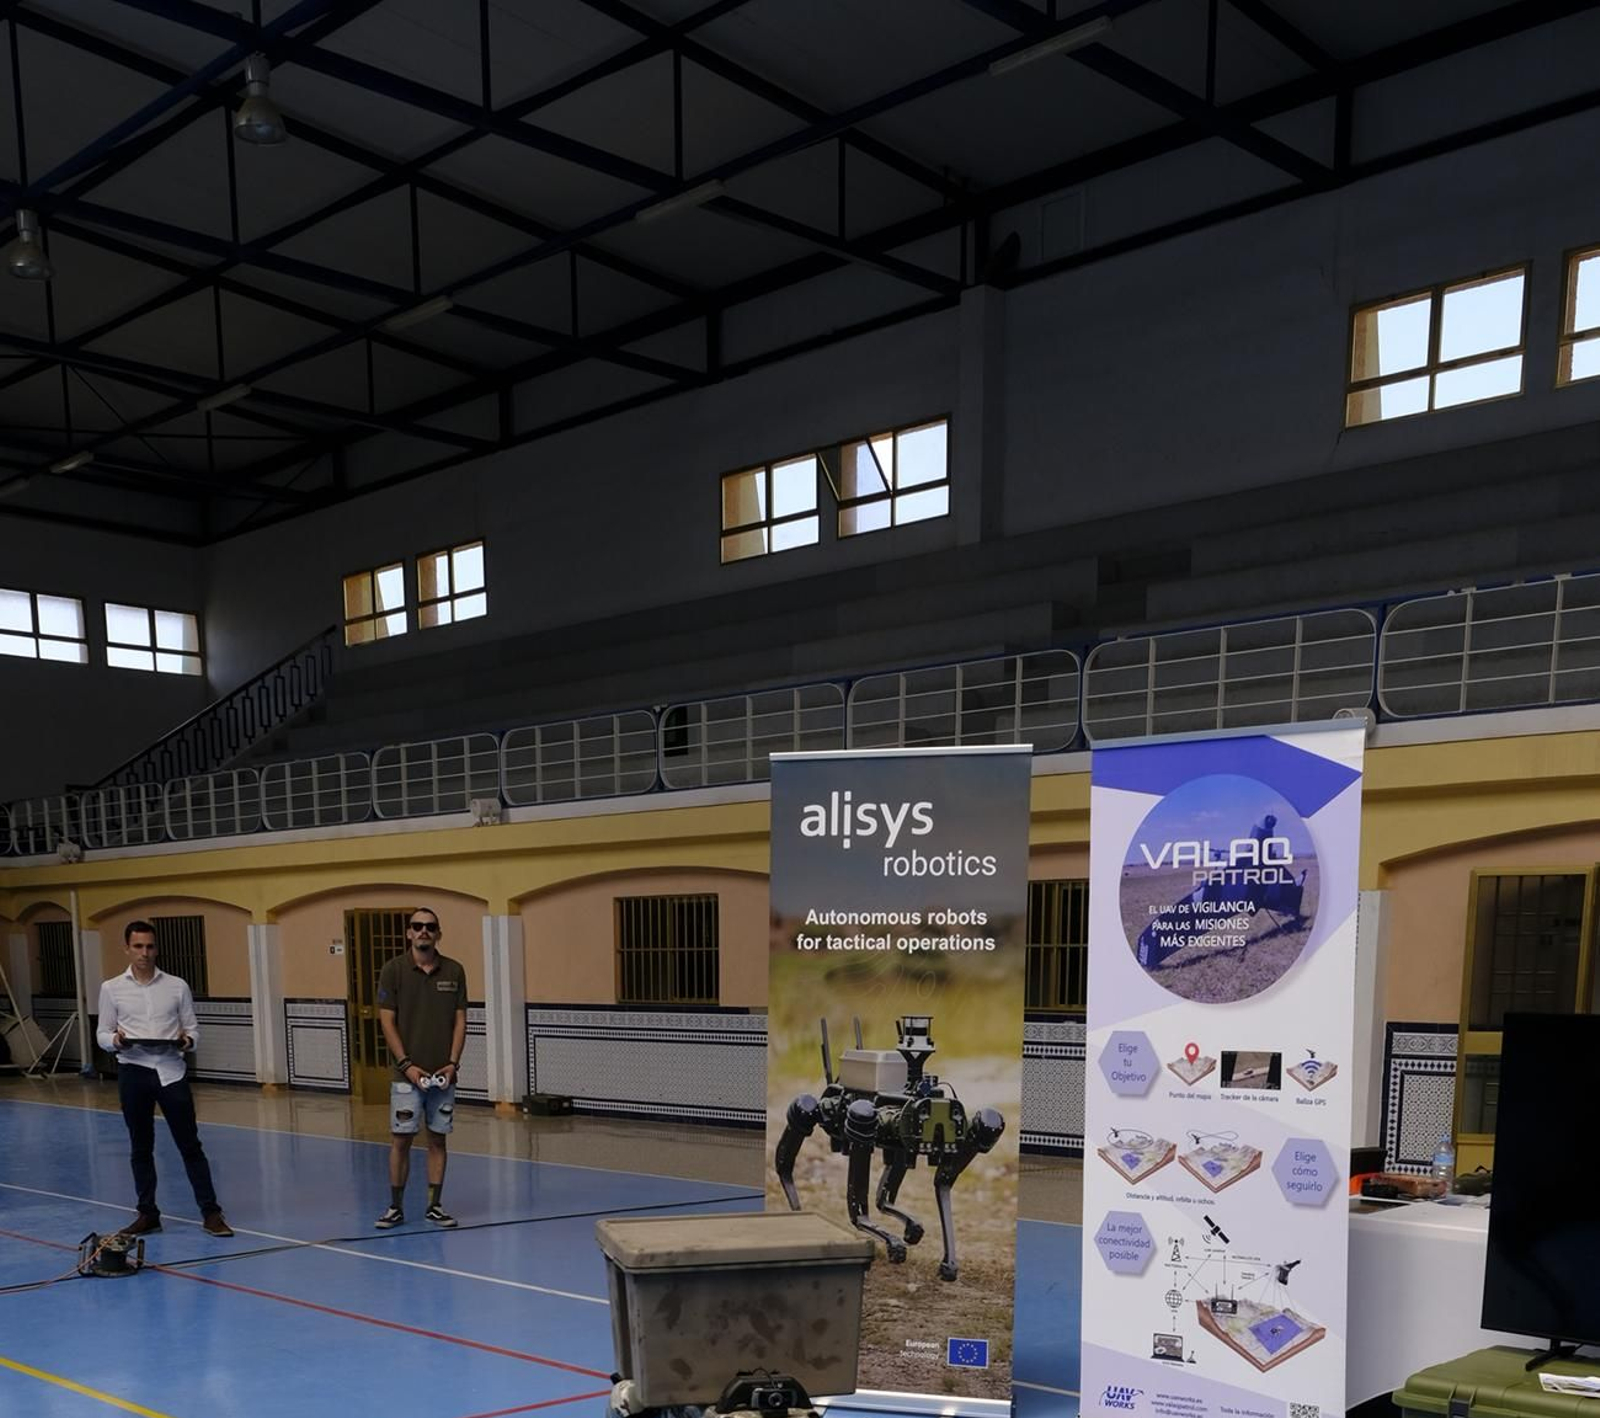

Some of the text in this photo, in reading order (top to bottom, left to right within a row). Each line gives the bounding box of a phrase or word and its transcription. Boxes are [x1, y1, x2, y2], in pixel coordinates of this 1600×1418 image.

[800, 791, 934, 849] alisys
[1140, 837, 1293, 869] VALAQ
[883, 850, 997, 877] robotics
[1192, 868, 1293, 886] PATROL
[1149, 901, 1256, 914] EL UAV DE VIGILANCIA
[805, 909, 988, 925] Autonomous robots
[1152, 918, 1249, 931] PARA LAS MISIONES
[797, 933, 996, 954] for tactical operations
[1160, 933, 1246, 947] MÁS EXIGENTES
[1118, 1043, 1138, 1055] Elige
[1124, 1059, 1132, 1067] tu
[1111, 1071, 1147, 1083] Objetivo
[1295, 1152, 1317, 1164] Elige
[1292, 1166, 1318, 1176] cómo
[1286, 1181, 1323, 1192] seguirlo
[1107, 1223, 1142, 1235] La mejor
[1099, 1237, 1150, 1248] conectividad
[1109, 1251, 1139, 1261] posible
[905, 1340, 939, 1349] European
[1106, 1385, 1135, 1401] UAV
[1104, 1399, 1136, 1410] WORKS
